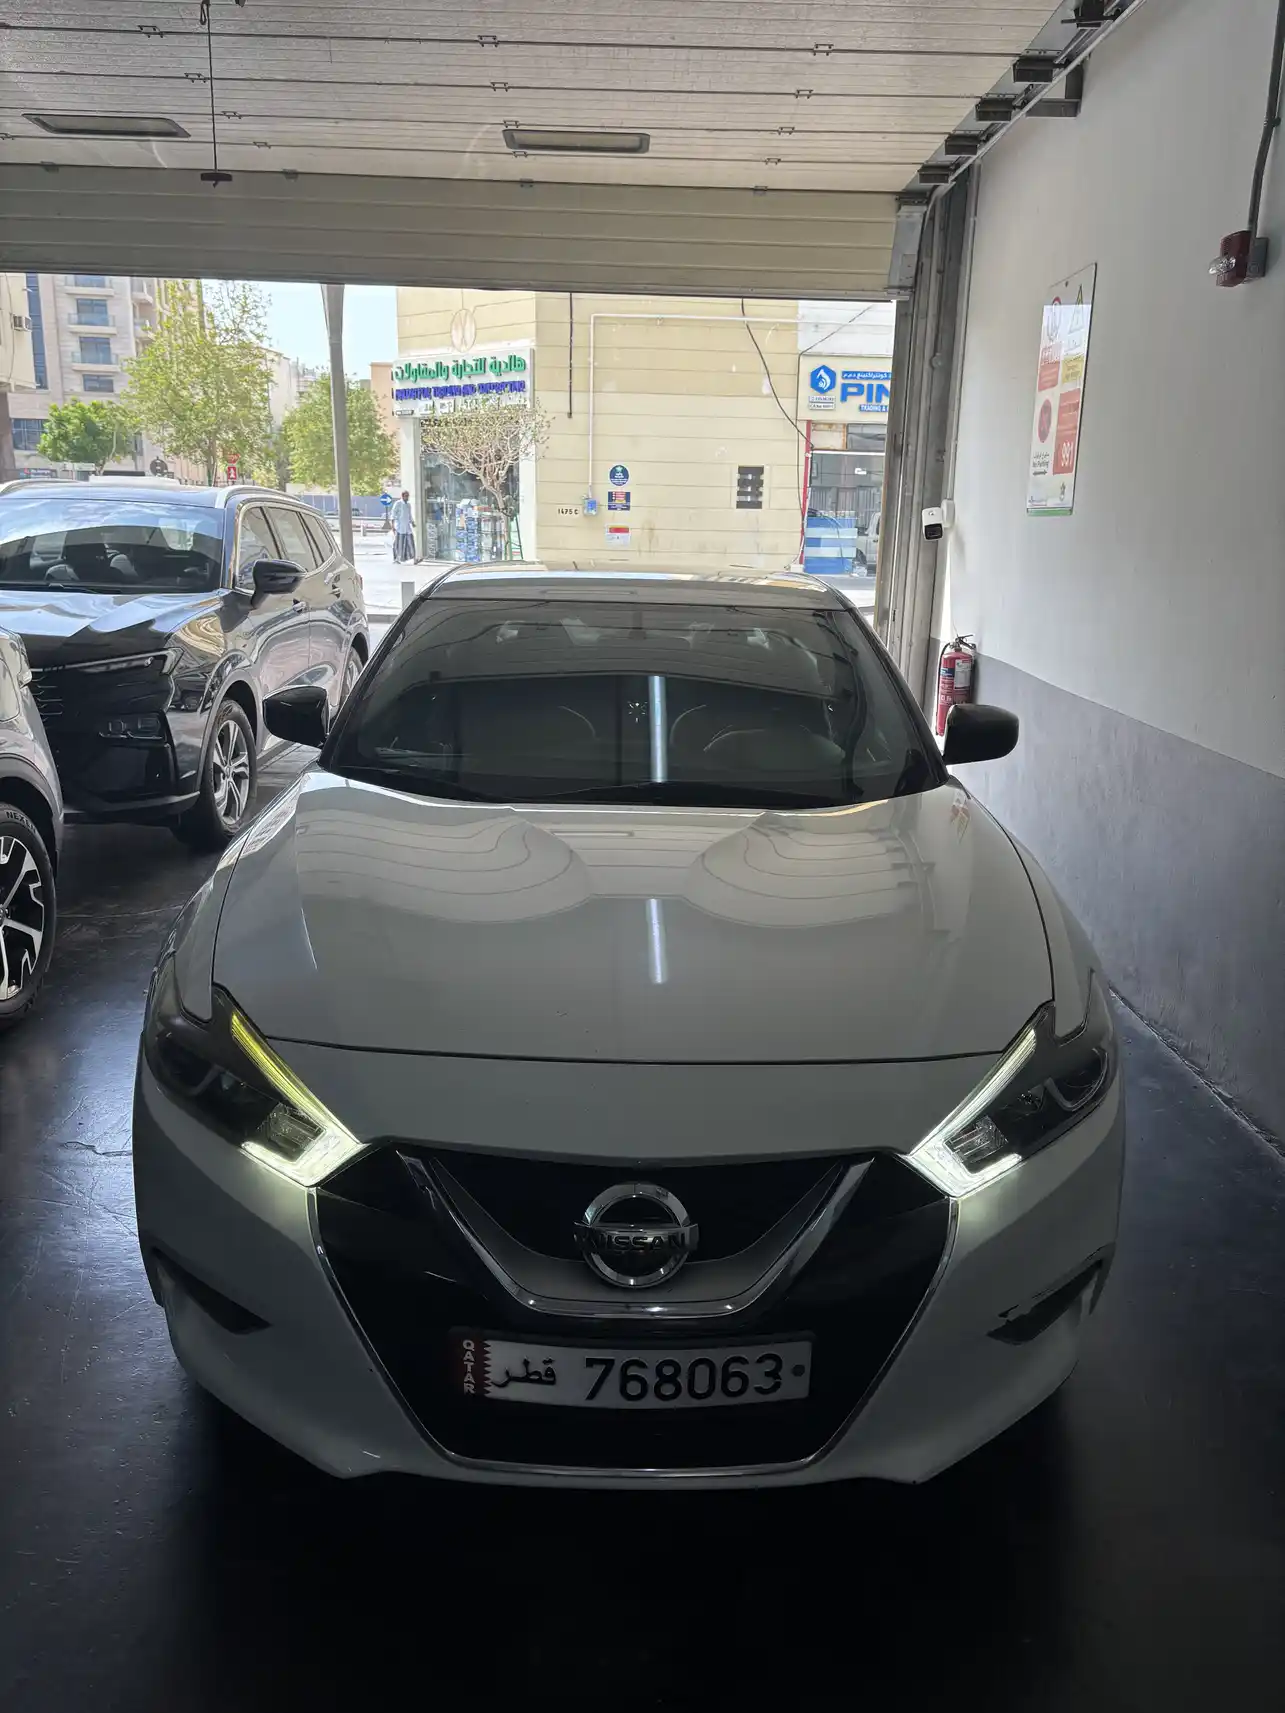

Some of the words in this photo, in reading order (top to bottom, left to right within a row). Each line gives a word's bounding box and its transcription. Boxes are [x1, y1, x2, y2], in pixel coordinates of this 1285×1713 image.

[395, 361, 450, 383] والمقاولات
[451, 357, 486, 379] للتجارة
[6, 811, 36, 834] NEXEN
[589, 1233, 687, 1251] NISSAN
[462, 1339, 478, 1397] QATAR
[491, 1358, 557, 1388] قطر
[585, 1354, 784, 1402] 768063
